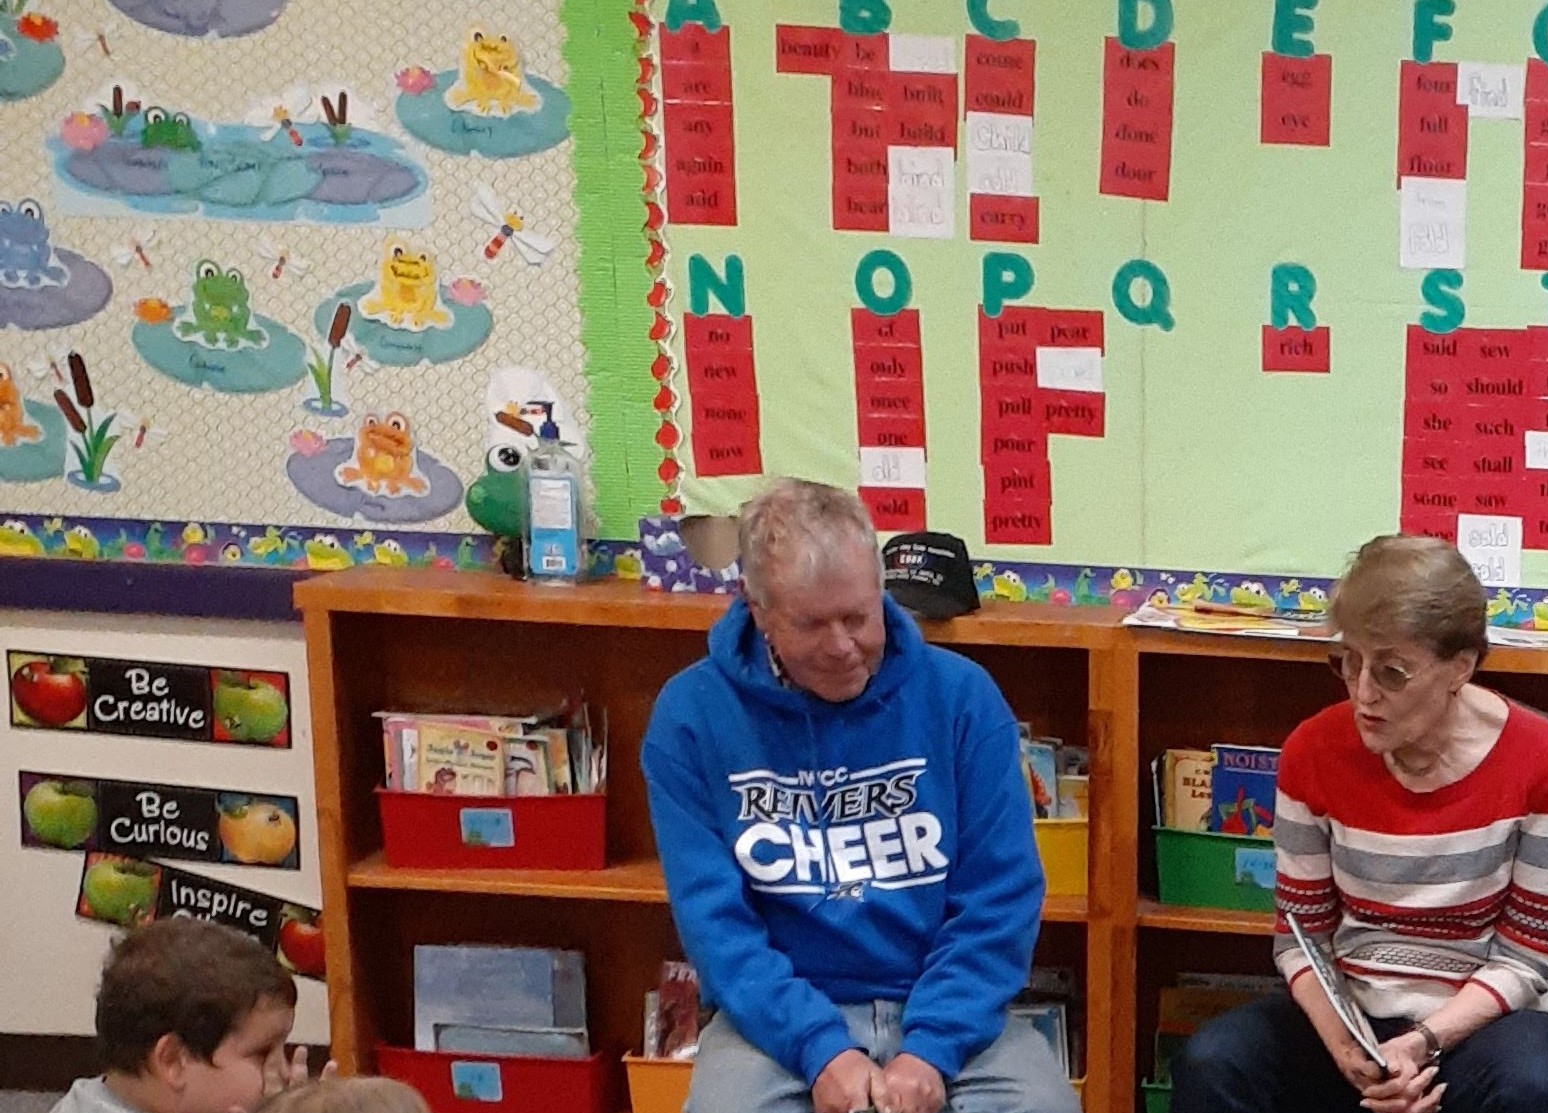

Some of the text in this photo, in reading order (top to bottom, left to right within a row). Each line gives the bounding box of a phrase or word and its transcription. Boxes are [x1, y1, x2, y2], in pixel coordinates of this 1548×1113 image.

[966, 0, 1020, 41] C
[1117, 0, 1173, 50] D
[1271, 0, 1319, 59] E
[1411, 0, 1457, 64] F
[975, 90, 1024, 110] could
[1419, 114, 1449, 134] full
[676, 156, 725, 177] again
[980, 207, 1027, 232] carry
[687, 253, 746, 318] N
[854, 249, 913, 317] O
[981, 251, 1036, 318] P
[1111, 258, 1175, 332] Q
[1269, 262, 1317, 331] R
[1417, 268, 1467, 334] S
[708, 329, 731, 344] no
[1279, 337, 1315, 359] rich
[1422, 338, 1458, 360] said
[703, 364, 739, 380] new
[869, 356, 906, 379] only
[992, 356, 1035, 378] push
[1429, 380, 1450, 397] so
[1466, 376, 1525, 399] should
[998, 396, 1033, 419] pull
[1044, 402, 1096, 426] pretty
[1422, 412, 1452, 432] she
[1474, 415, 1516, 437] such
[876, 433, 908, 446] one
[709, 446, 745, 462] now
[1472, 455, 1514, 474] shall
[1000, 474, 1036, 494] pint
[1411, 491, 1458, 508] some
[991, 512, 1043, 534] pretty
[124, 668, 170, 697] Be
[94, 694, 207, 730] Creative
[797, 766, 850, 788] NCC
[135, 791, 181, 820] Be
[110, 817, 210, 852] Curious
[734, 811, 950, 884] CHEER
[170, 878, 269, 928] Inspire
